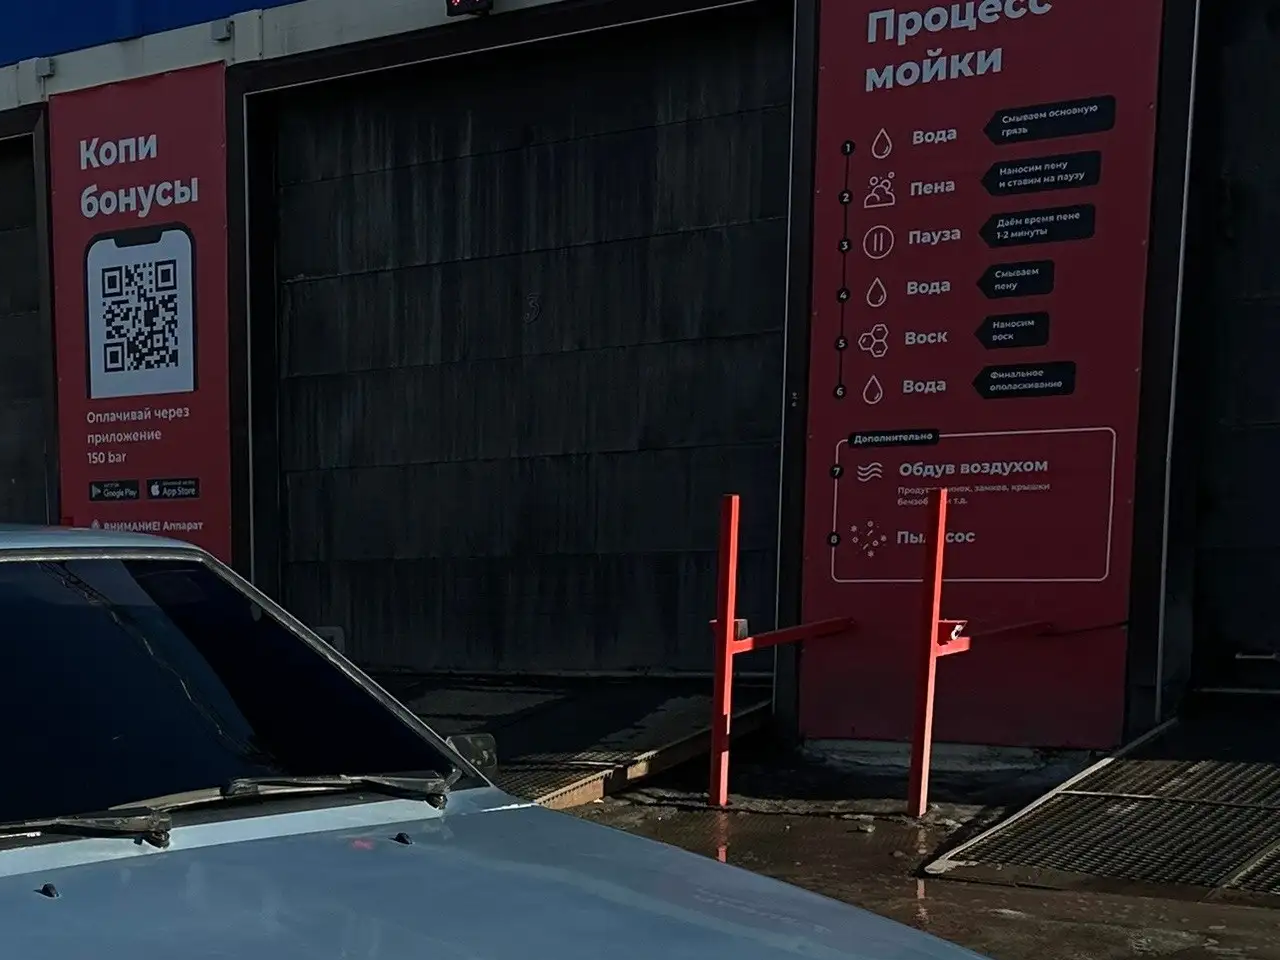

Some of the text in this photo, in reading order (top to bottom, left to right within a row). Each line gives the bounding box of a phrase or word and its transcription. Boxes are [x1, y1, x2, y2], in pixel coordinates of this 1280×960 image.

[866, 0, 1053, 46] Процесс
[865, 47, 1003, 92] мойки
[1001, 103, 1099, 125] Смываем основную
[912, 127, 958, 146] Вода
[79, 133, 158, 170] Копи
[999, 160, 1069, 176] Наносим пену
[1007, 176, 1042, 188] ставим
[1043, 175, 1056, 185] на
[1057, 171, 1086, 185] паузу
[909, 180, 956, 198] Пена
[80, 177, 200, 219] бонусы
[842, 193, 850, 202] 2
[1023, 214, 1056, 229] время
[908, 227, 962, 246] Пауза
[996, 228, 1048, 240] 1-2 минуты
[841, 241, 849, 250] 3
[994, 267, 1040, 279] Смываем
[906, 279, 952, 297] Вода
[994, 281, 1018, 292] пену
[839, 290, 847, 299] 4
[992, 319, 1035, 329] Наносим
[838, 339, 845, 348] 5
[904, 330, 948, 346] Воск
[836, 387, 844, 396] 6
[902, 379, 947, 395] Вода
[86, 406, 190, 424] Оплачивай через
[87, 429, 162, 447] приложение
[853, 431, 933, 445] Дополнительно
[86, 451, 127, 464] 150 bar
[833, 466, 840, 476] 7
[899, 459, 1049, 478] Обдув воздухом
[162, 486, 196, 497] App Store
[163, 521, 204, 532] Аппарат
[896, 530, 976, 544] Пысос
